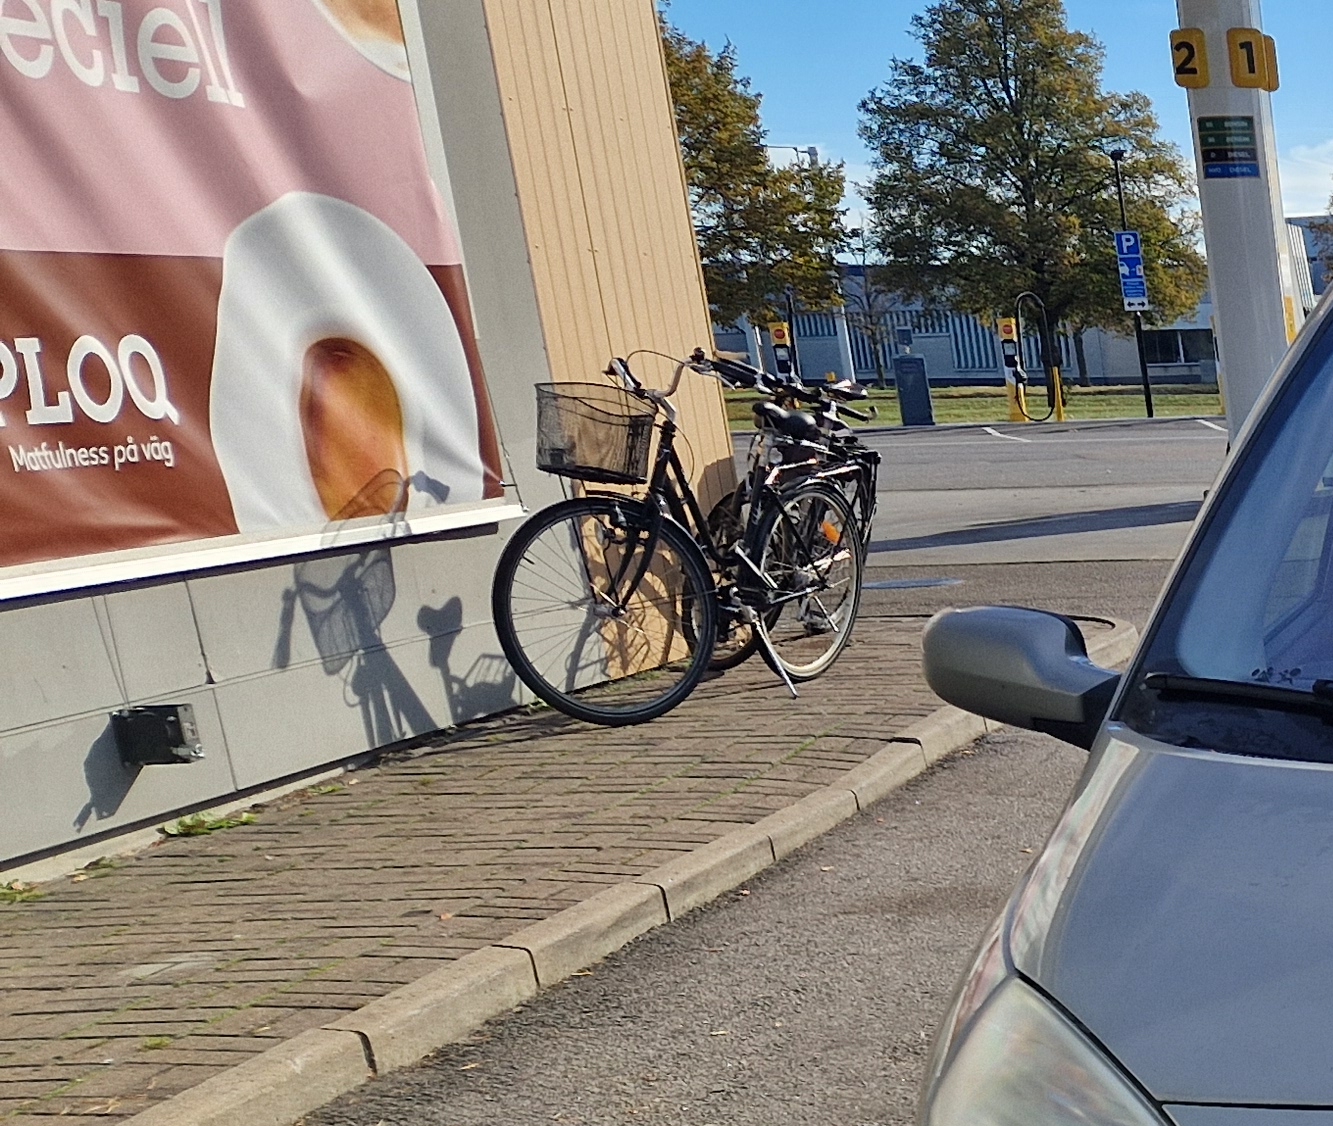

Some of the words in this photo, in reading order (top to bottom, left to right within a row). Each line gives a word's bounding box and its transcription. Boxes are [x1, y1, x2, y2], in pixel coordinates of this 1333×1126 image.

[0, 0, 246, 108] eciell
[1174, 41, 1198, 75] 2
[1238, 41, 1256, 75] 1
[1121, 234, 1135, 253] P
[8, 440, 109, 472] Matfulness
[113, 435, 139, 471] på
[140, 434, 175, 468] väg
